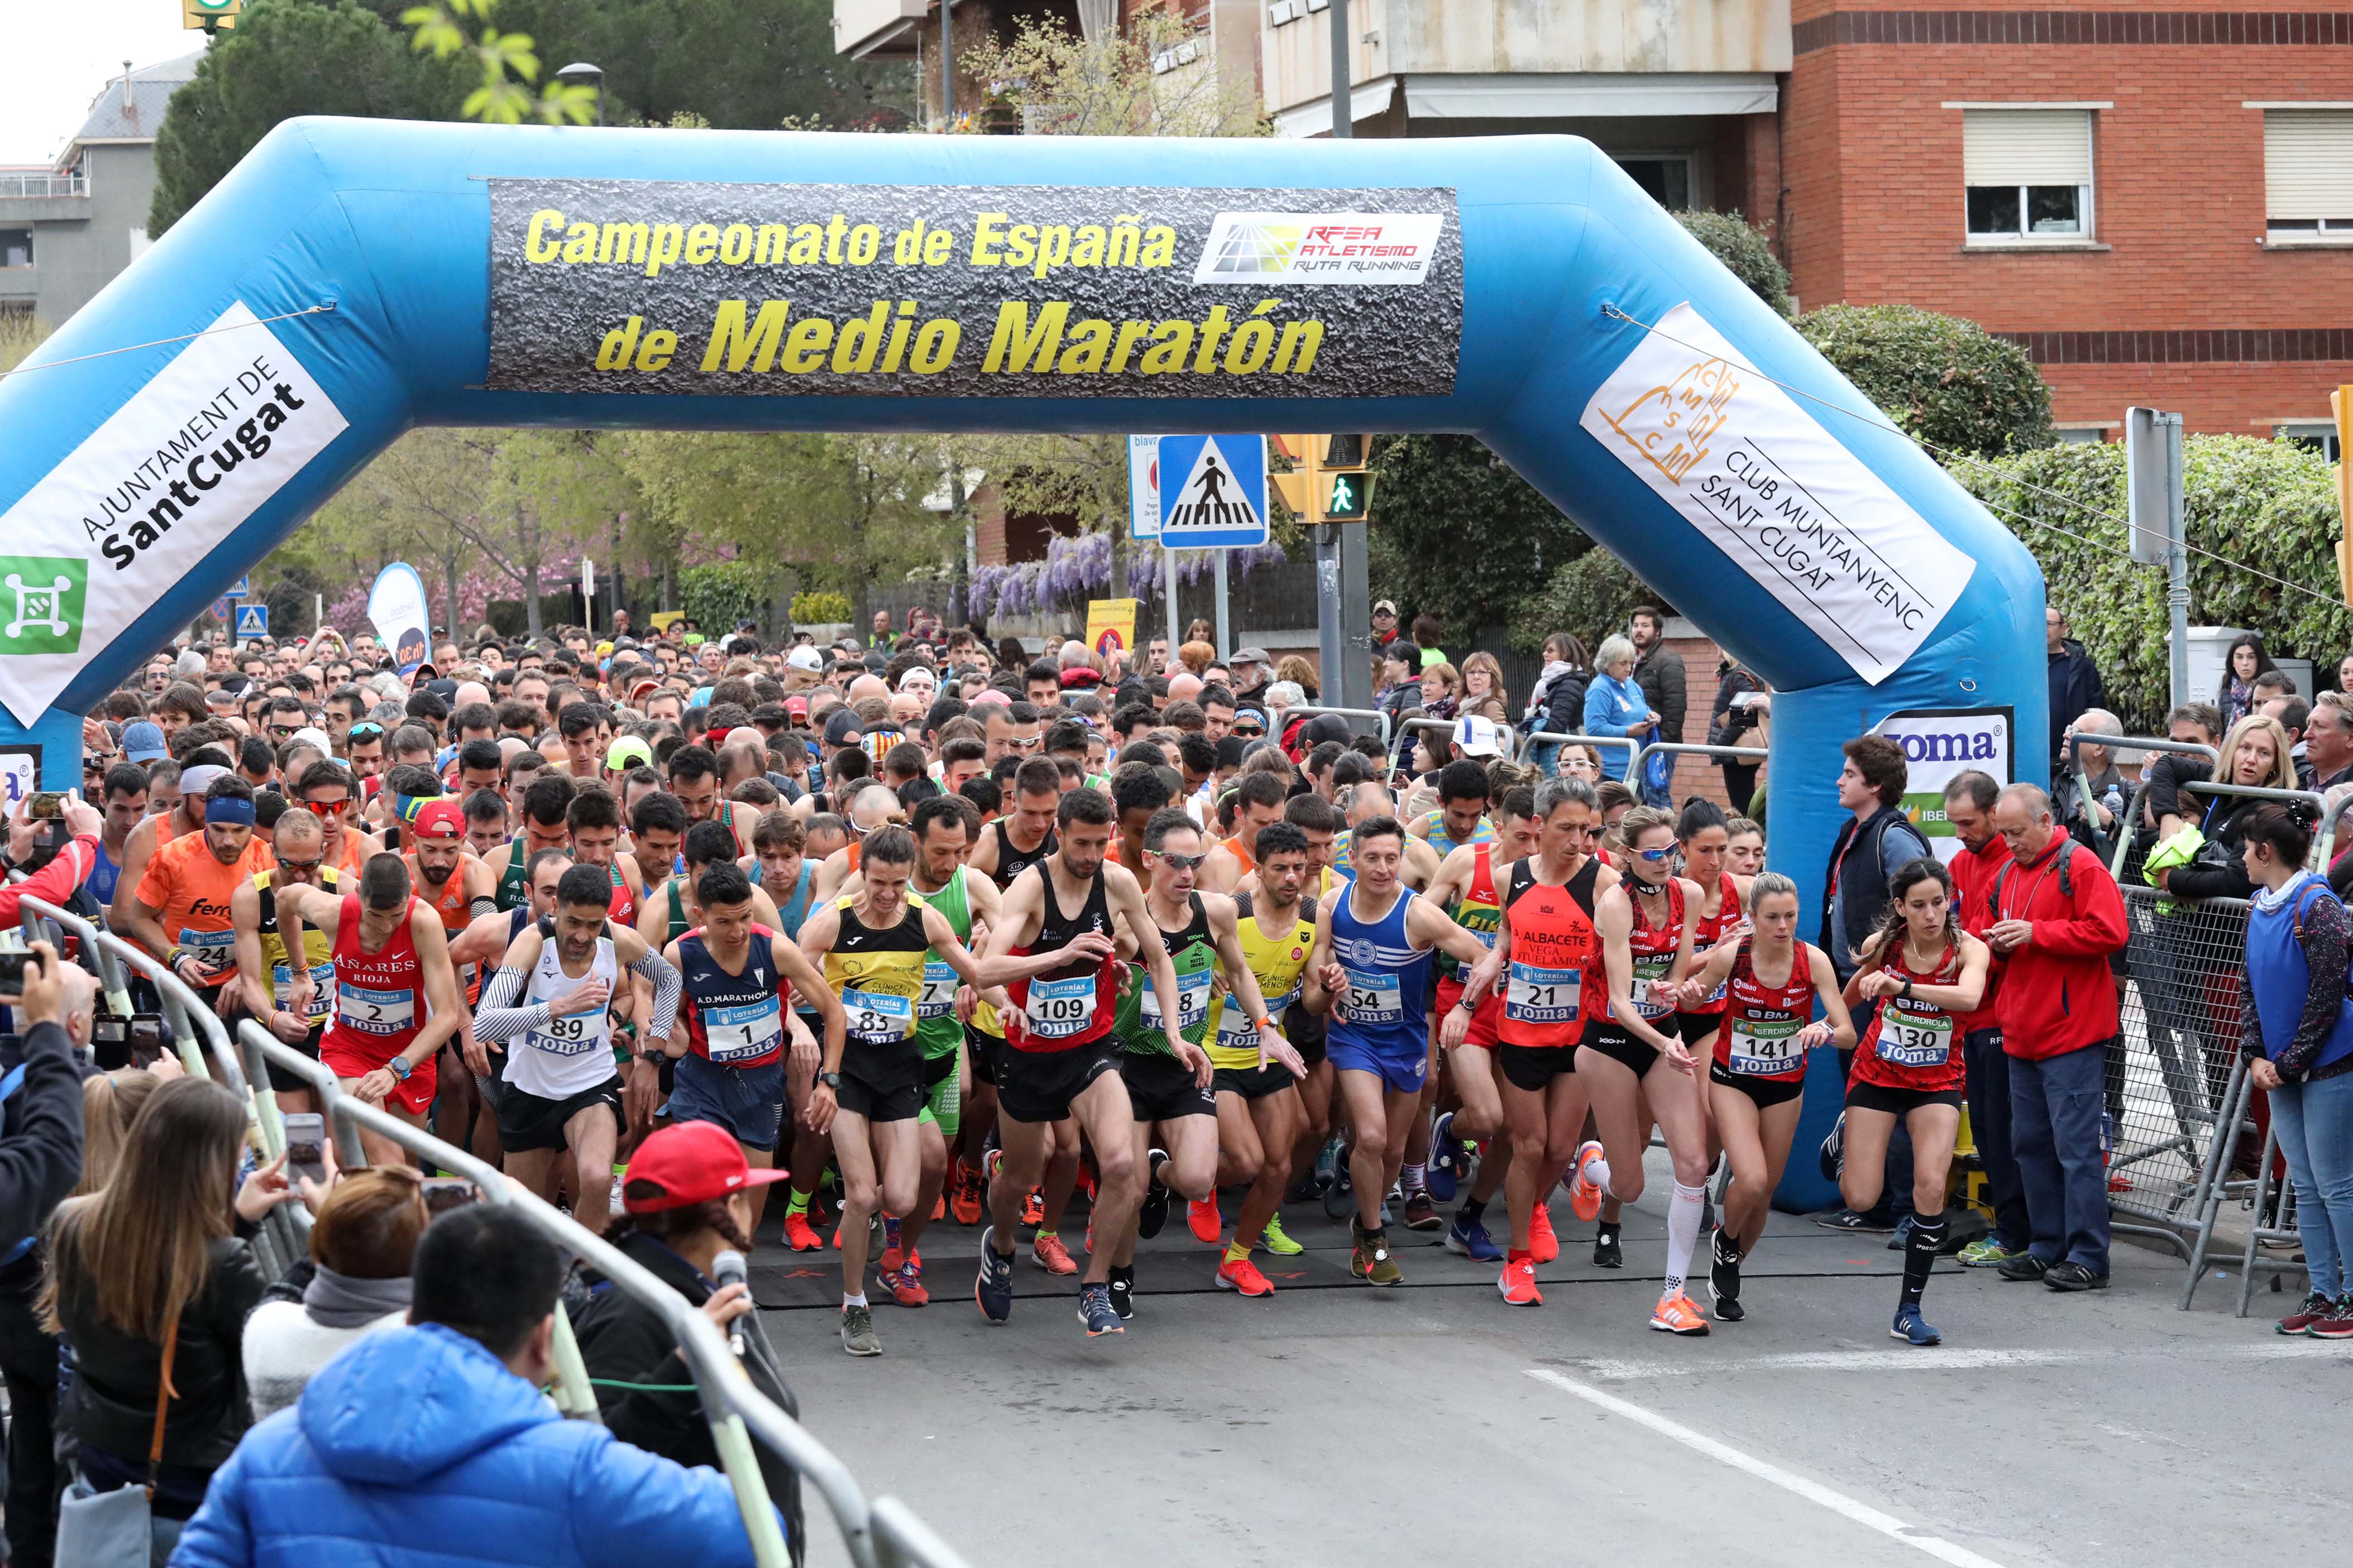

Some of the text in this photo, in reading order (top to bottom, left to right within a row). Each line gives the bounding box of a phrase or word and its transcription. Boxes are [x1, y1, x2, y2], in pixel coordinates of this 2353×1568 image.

[525, 209, 1175, 279] Campeonato de España
[1299, 245, 1417, 257] ATLETISMO
[1293, 261, 1423, 273] RUTA RUNNING
[595, 300, 1324, 374] de Medio Maratón
[82, 355, 278, 542] AJUNTAMENT DE
[101, 382, 304, 570] SantCugat
[1701, 474, 1835, 593] SANT CUGAT
[1726, 450, 1924, 631] CLUB MUNTANYENC
[189, 898, 232, 917] Ferr
[206, 933, 235, 942] LOTERÍA
[1523, 931, 1587, 947] ALBACETE
[198, 947, 227, 963] 24
[1529, 944, 1560, 956] VEGA
[1630, 943, 1654, 952] uedan
[334, 953, 415, 973] AÑARES
[1652, 952, 1675, 964] BM
[353, 974, 391, 984] RIOJA
[1176, 976, 1202, 986] OTERÍAS
[1355, 976, 1386, 985] LOTERÍAS
[1734, 978, 1757, 991] Bilbao
[314, 982, 324, 1001] 2
[923, 983, 938, 1002] 7
[1050, 984, 1085, 992] LOTERÍAS
[1528, 985, 1555, 1006] 21
[698, 990, 768, 1004] A.D.MARATHON
[870, 999, 901, 1008] OTERÍAS
[1179, 992, 1192, 1012] 8
[1351, 988, 1380, 1009] 54
[1734, 991, 1764, 1004] Guedan
[281, 1000, 332, 1013] Jma
[368, 1005, 383, 1022] 2
[733, 1005, 769, 1019] LOTERÍAS
[917, 1004, 944, 1017] ma
[1039, 999, 1083, 1019] 109
[1342, 1005, 1394, 1022] Joma
[1513, 1005, 1570, 1021] Joma
[1914, 1000, 1939, 1012] BM
[859, 1011, 888, 1032] 83
[1764, 1011, 1790, 1020] BM
[1900, 1013, 1948, 1028] IBERDROLA
[551, 1019, 583, 1040] 89
[740, 1025, 752, 1044] 1
[1754, 1024, 1800, 1035] IBERDROLA
[1893, 1025, 1937, 1048] 130
[532, 1034, 590, 1054] Joma
[1223, 1032, 1260, 1046] Jom
[1989, 1036, 2003, 1045] RF
[1746, 1038, 1788, 1058] 141
[1882, 1044, 1938, 1063] Joma
[1736, 1058, 1795, 1072] Joma
